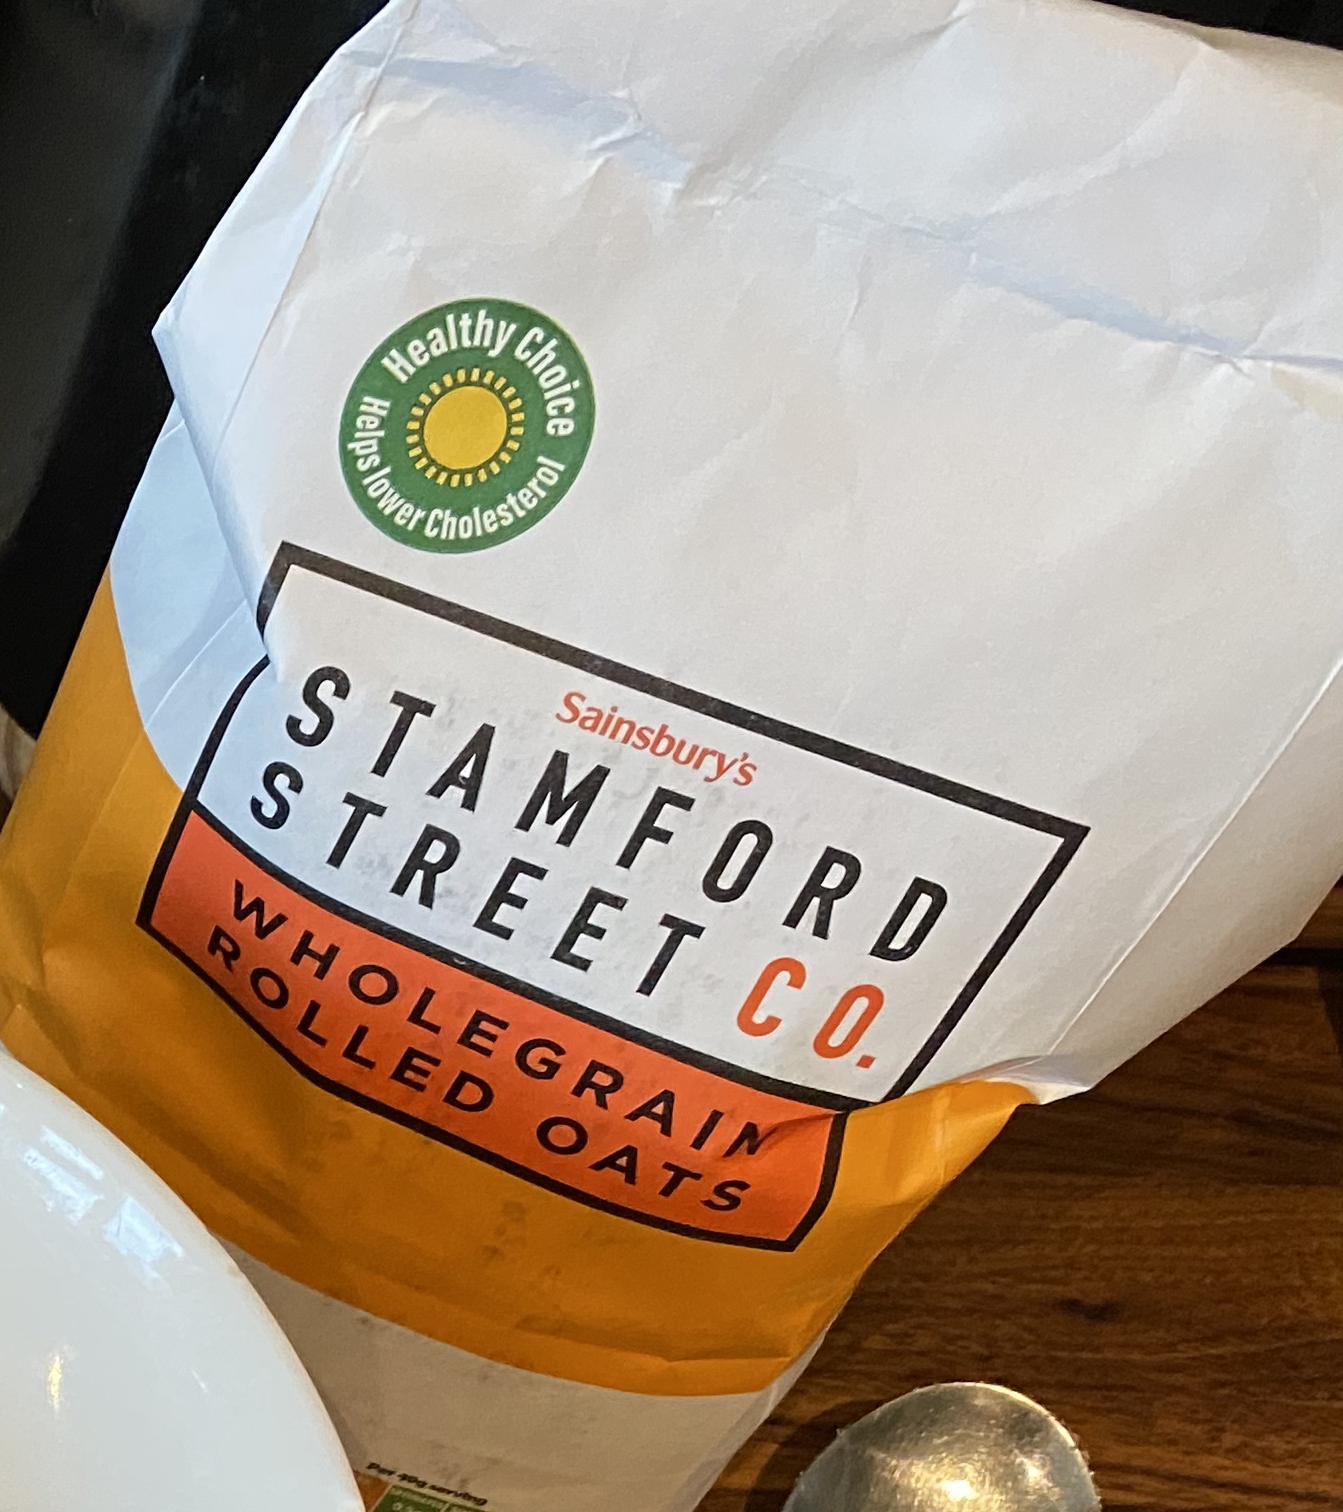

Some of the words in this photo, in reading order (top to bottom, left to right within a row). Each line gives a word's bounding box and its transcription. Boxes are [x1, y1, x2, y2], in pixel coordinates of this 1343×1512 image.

[346, 395, 391, 472] Helps
[380, 308, 517, 385] Healthy
[513, 325, 581, 438] Choice
[362, 466, 427, 532] lower
[423, 454, 567, 541] Cholesterol
[555, 690, 759, 788] Sainsbury's
[284, 664, 950, 964] STAMFORD
[249, 760, 706, 997] STREET
[736, 954, 889, 1070] CO.
[206, 924, 496, 1115] ROLLED
[536, 1114, 751, 1215] OATS
[231, 877, 777, 1160] WHOLEGRAIN
